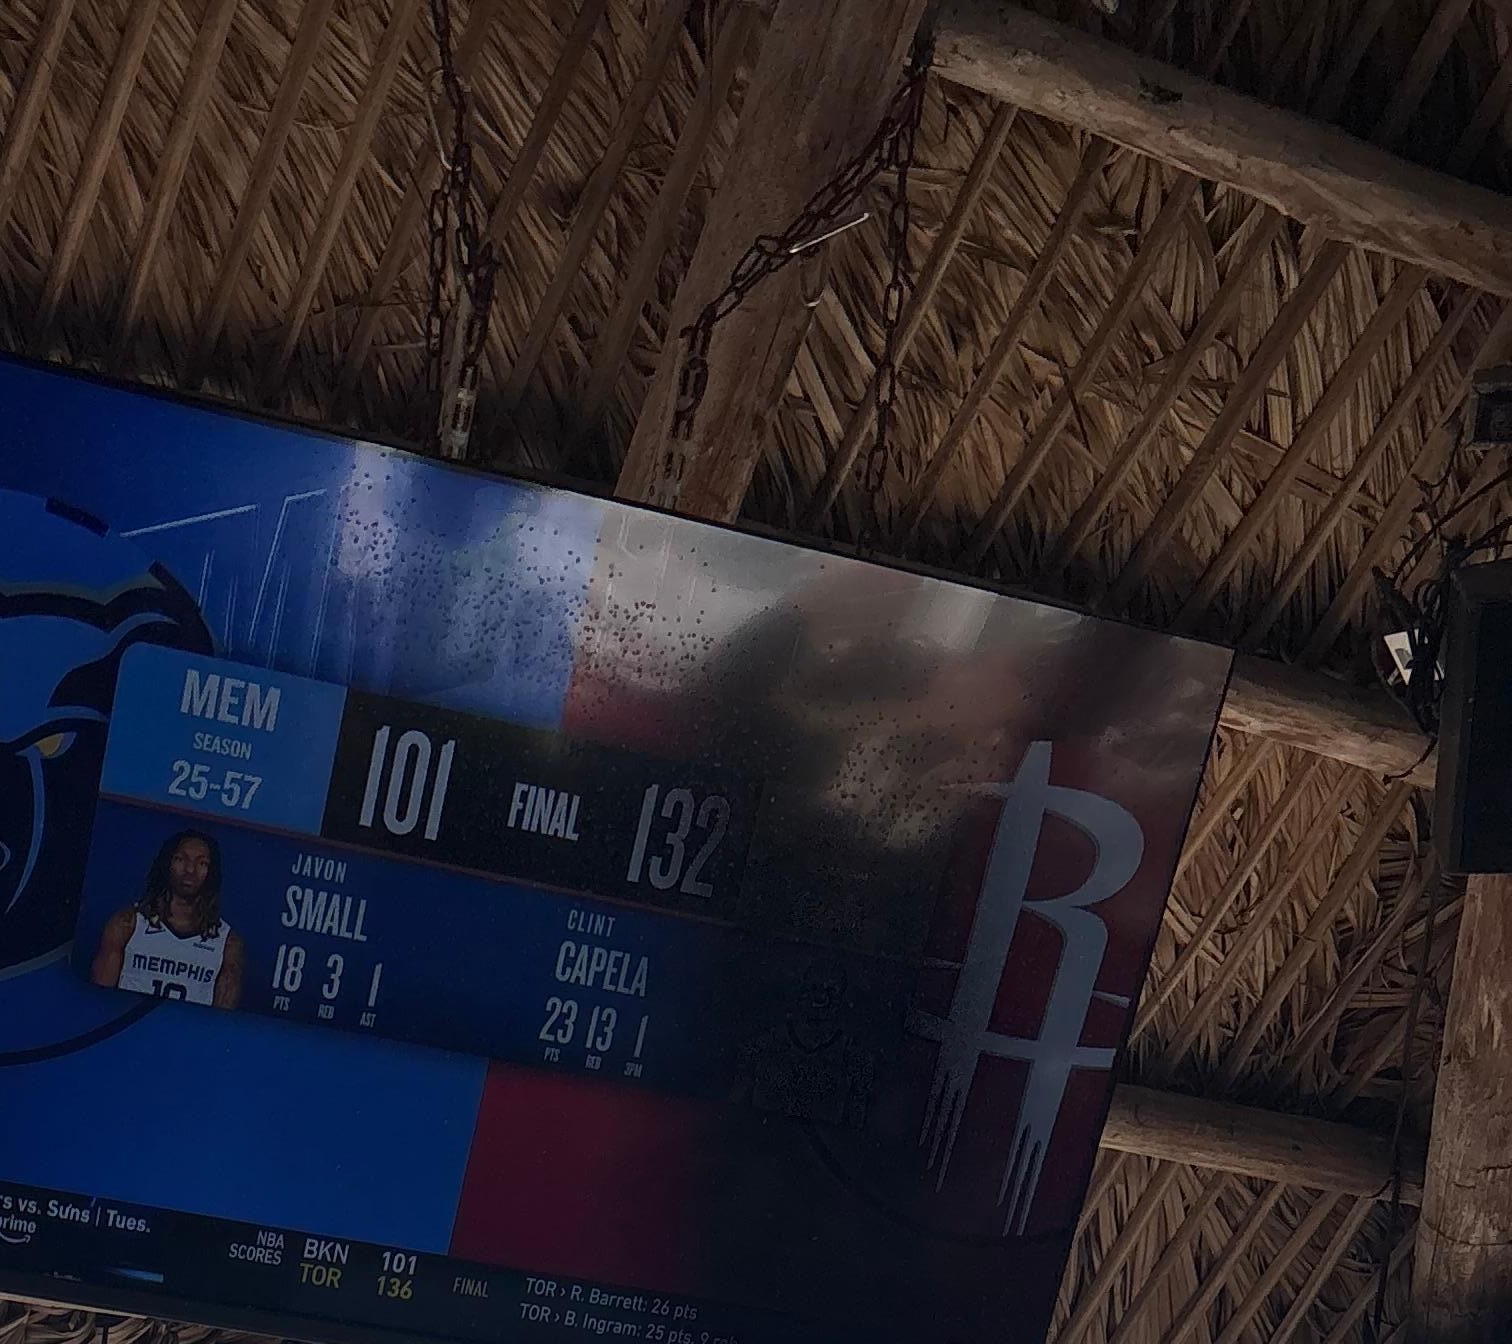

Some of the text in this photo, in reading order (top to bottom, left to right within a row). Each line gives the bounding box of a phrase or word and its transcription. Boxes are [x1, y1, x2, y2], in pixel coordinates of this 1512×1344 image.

[180, 668, 281, 732] MEM
[193, 732, 252, 760] SEASON
[168, 760, 262, 809] 25-57
[359, 725, 456, 841] 101
[507, 781, 581, 841] FINAL
[626, 783, 730, 898] 132
[292, 852, 347, 883] JAVON
[281, 885, 367, 942] SMALL
[567, 909, 616, 937] CLINT
[132, 954, 215, 983] MEMPHIS
[272, 943, 383, 1008] 18 3 1
[555, 940, 648, 997] CAPELA
[273, 995, 377, 1027] PTS REB AST
[538, 996, 648, 1058] 23 13 1
[544, 1046, 643, 1078] PTS REB 3PM
[18, 1199, 42, 1215] vs.
[47, 1200, 90, 1223] Suns
[107, 1209, 151, 1233] Tues.
[228, 1243, 282, 1266] SCORES
[257, 1231, 285, 1249] NBA
[303, 1238, 418, 1275] BKN 101
[299, 1263, 413, 1300] TOR 136
[452, 1277, 489, 1298] FINAL
[527, 1277, 698, 1321] TOR R. Barrett: 26 pts
[520, 1302, 552, 1323] TOR
[564, 1310, 579, 1328] B.
[582, 1313, 642, 1337] Ingram:
[646, 1323, 665, 1340] 25
